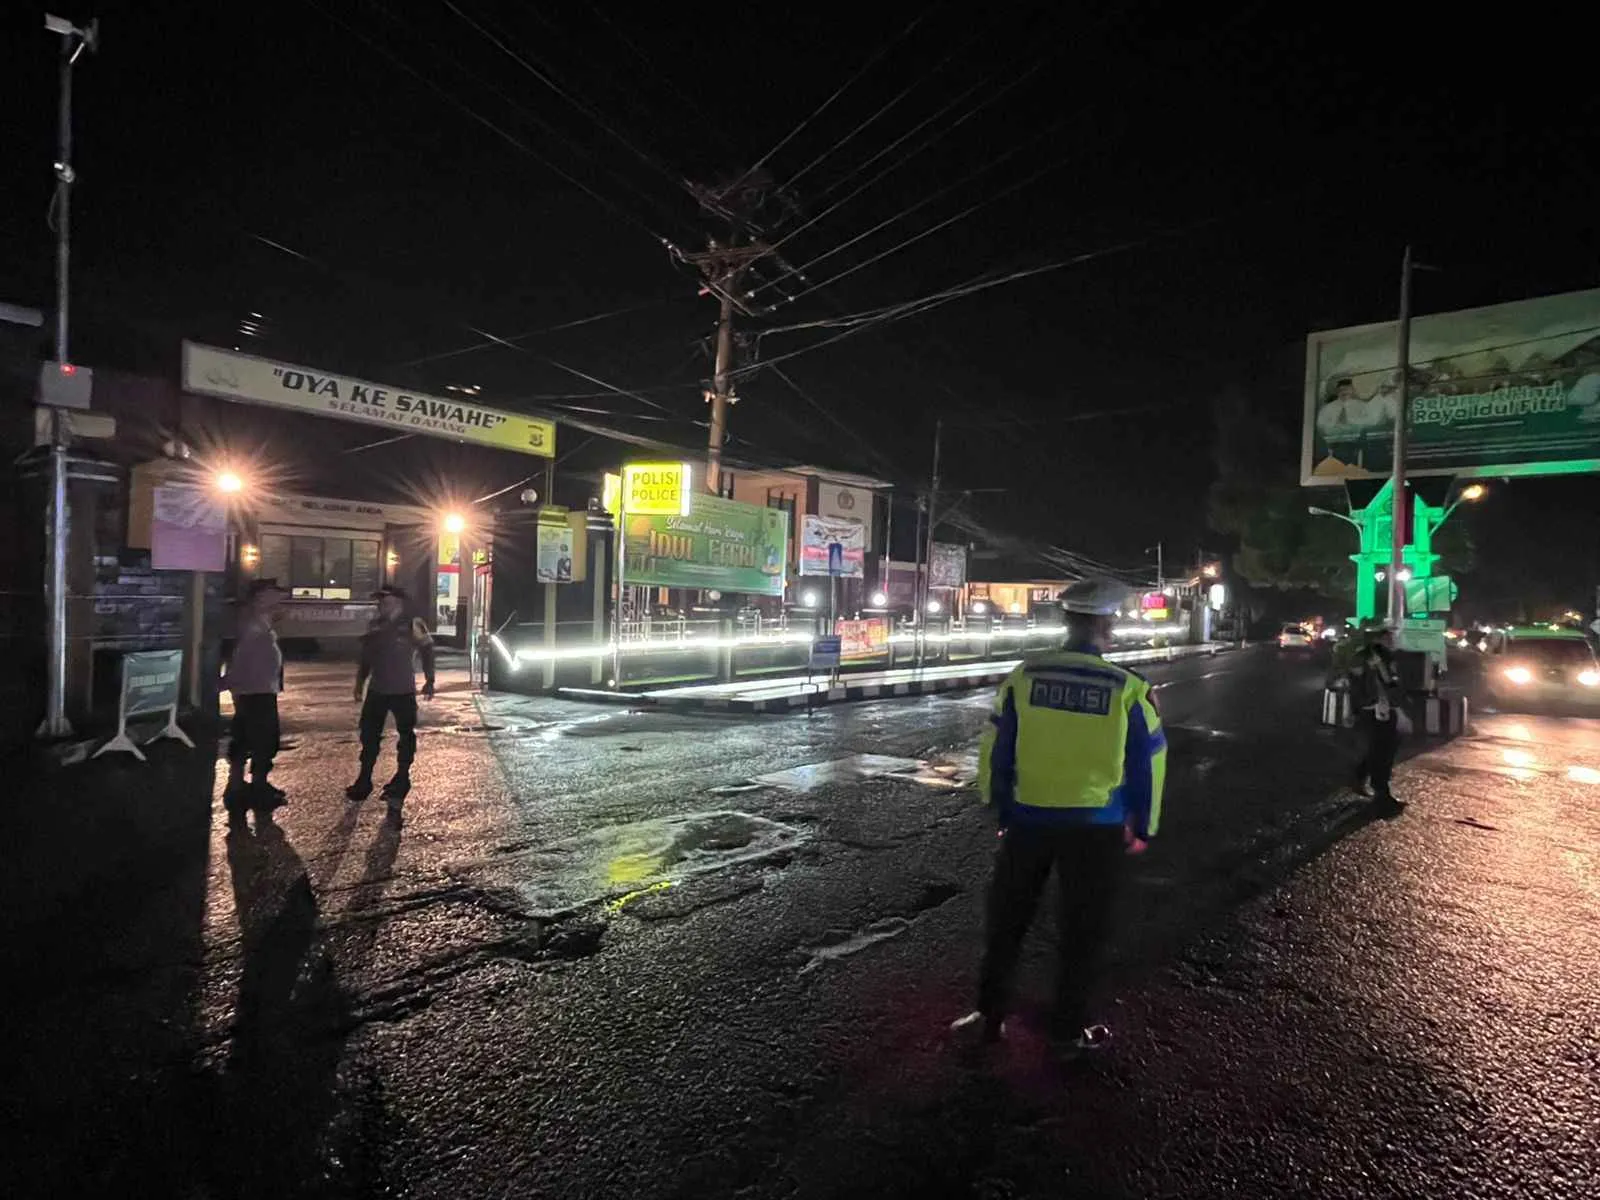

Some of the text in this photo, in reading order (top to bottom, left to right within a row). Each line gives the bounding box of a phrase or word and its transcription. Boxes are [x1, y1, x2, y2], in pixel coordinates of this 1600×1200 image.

[274, 368, 507, 429] "OYA KE SAWAHE"
[632, 471, 679, 486] POLISI
[631, 489, 678, 501] POLICE
